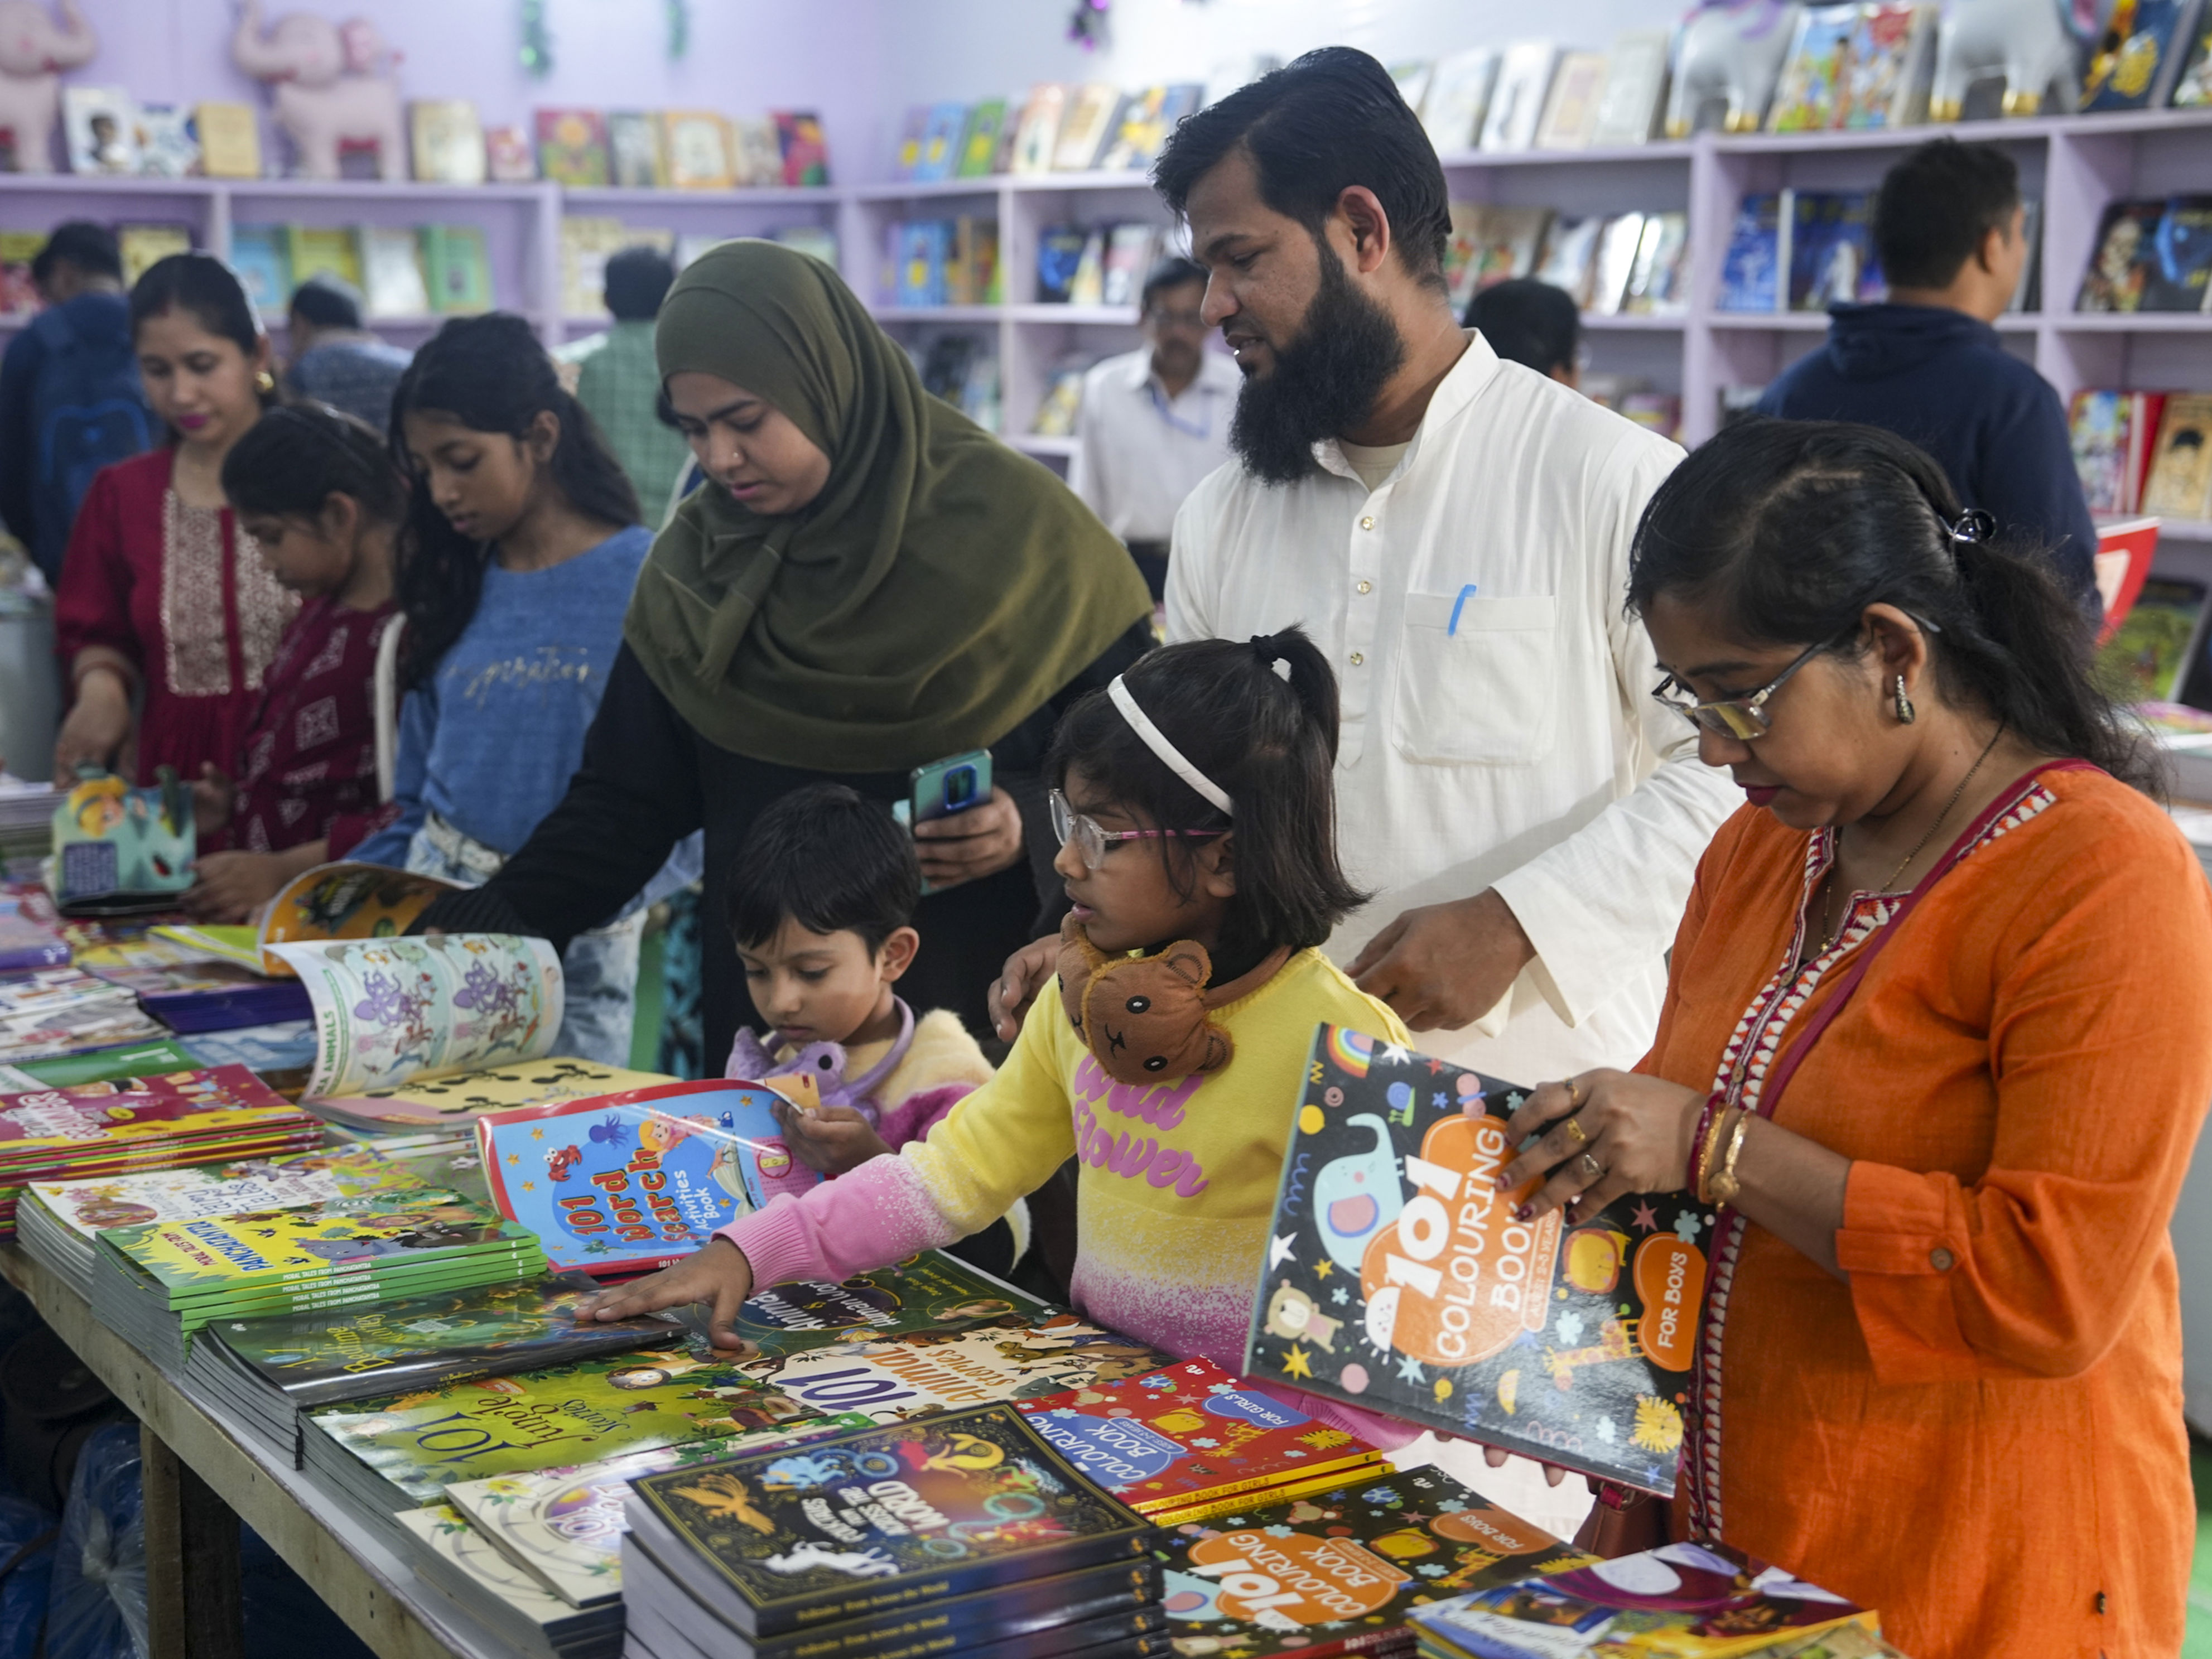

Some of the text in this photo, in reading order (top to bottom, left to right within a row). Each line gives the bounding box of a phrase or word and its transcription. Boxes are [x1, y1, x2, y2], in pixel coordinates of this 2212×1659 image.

[323, 1010, 337, 1072] ANIMALS
[558, 1195, 610, 1236] 101
[590, 1169, 656, 1242] word
[625, 1147, 701, 1242] search
[674, 1170, 712, 1230] Activities
[695, 1187, 720, 1219] Book
[181, 1221, 275, 1272] PANCHATANTRA
[1386, 1154, 1463, 1299] 101
[1436, 1127, 1505, 1358] COLOURING
[283, 1272, 301, 1280] MORAL
[333, 1262, 372, 1274] PANCHATANTRA
[333, 1275, 372, 1285] PANCHATANTRA
[292, 1294, 311, 1303] MORAL
[342, 1283, 380, 1294] PANCHATANTRA
[292, 1303, 311, 1311] MORAL
[311, 1300, 326, 1309] TALES
[342, 1293, 380, 1304] PANCHATANTRA
[745, 1290, 827, 1331] Anima
[797, 1281, 902, 1327] Human Wor
[1657, 1251, 1688, 1348] FOR BOYS
[775, 1368, 918, 1411] 101
[862, 1346, 997, 1402] Animal
[470, 1396, 599, 1449] Jungle
[560, 1399, 631, 1433] Stories
[1224, 1394, 1289, 1425] FOR GIRLS
[391, 1411, 529, 1464] 101
[1027, 1416, 1147, 1480] COLOURING
[1085, 1424, 1158, 1458] BOOK
[868, 1480, 951, 1531] WORLD
[1159, 1506, 1208, 1525] COLOURING
[1211, 1501, 1236, 1513] BOOK
[1257, 1488, 1286, 1501] GIRLS
[1194, 1489, 1220, 1501] BOOK
[1222, 1486, 1238, 1494] FOR
[1241, 1478, 1270, 1491] GIRLS
[1459, 1515, 1525, 1550] FOR BOYS
[920, 1580, 950, 1595] World
[1187, 1558, 1306, 1610] 101
[1228, 1533, 1368, 1614] COLOURING
[1300, 1545, 1381, 1588] BOOK
[920, 1615, 950, 1629] World
